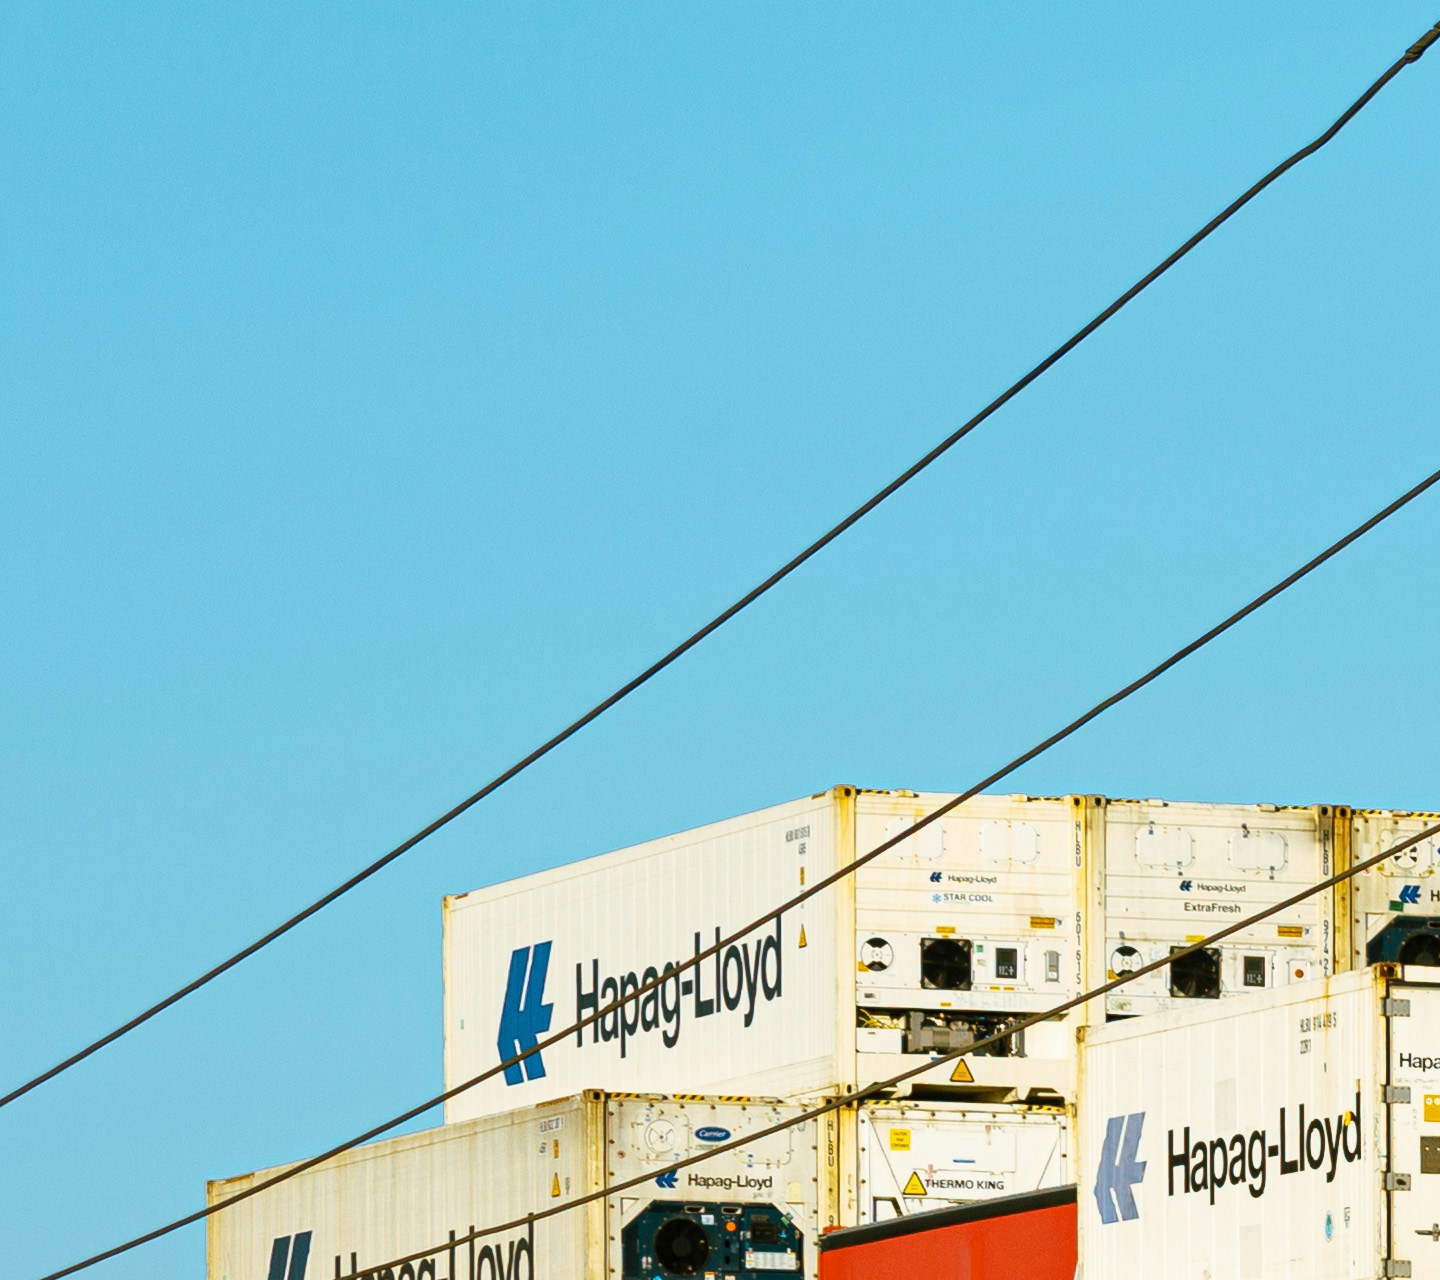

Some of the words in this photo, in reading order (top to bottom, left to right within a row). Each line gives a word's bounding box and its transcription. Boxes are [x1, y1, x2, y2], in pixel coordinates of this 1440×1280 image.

[1197, 882, 1246, 893] Hapag-Lloyd
[1183, 902, 1241, 914] ExtraFresh
[576, 913, 782, 1058] Hapag-Lloyd
[698, 1128, 728, 1140] Carrier
[1167, 1079, 1363, 1206] Hapag-Lloyd
[688, 1174, 773, 1189] Hapag-Lloyd
[925, 1179, 973, 1191] THERMO
[976, 1180, 1004, 1191] KING
